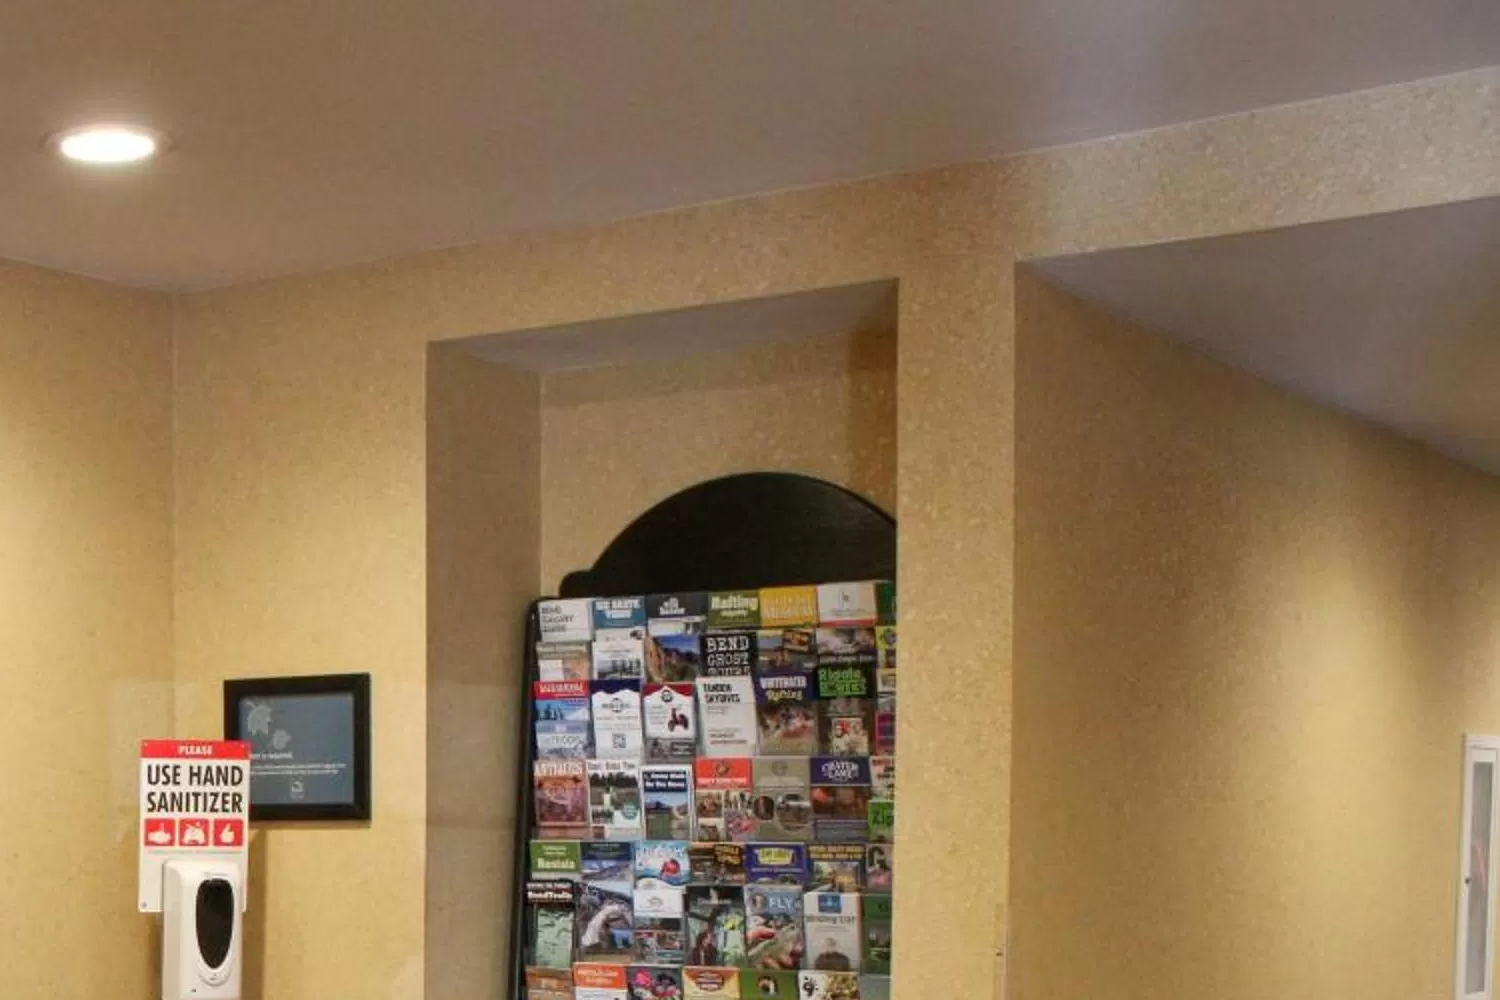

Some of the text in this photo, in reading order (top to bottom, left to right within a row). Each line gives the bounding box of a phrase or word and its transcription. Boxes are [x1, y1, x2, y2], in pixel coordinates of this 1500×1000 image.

[706, 635, 749, 653] BEND
[706, 652, 749, 667] GHOST
[178, 745, 213, 755] PLEASE
[147, 764, 181, 786] USE
[189, 764, 243, 786] HAND
[147, 791, 243, 813] SANITIZER
[769, 897, 793, 909] FLY
